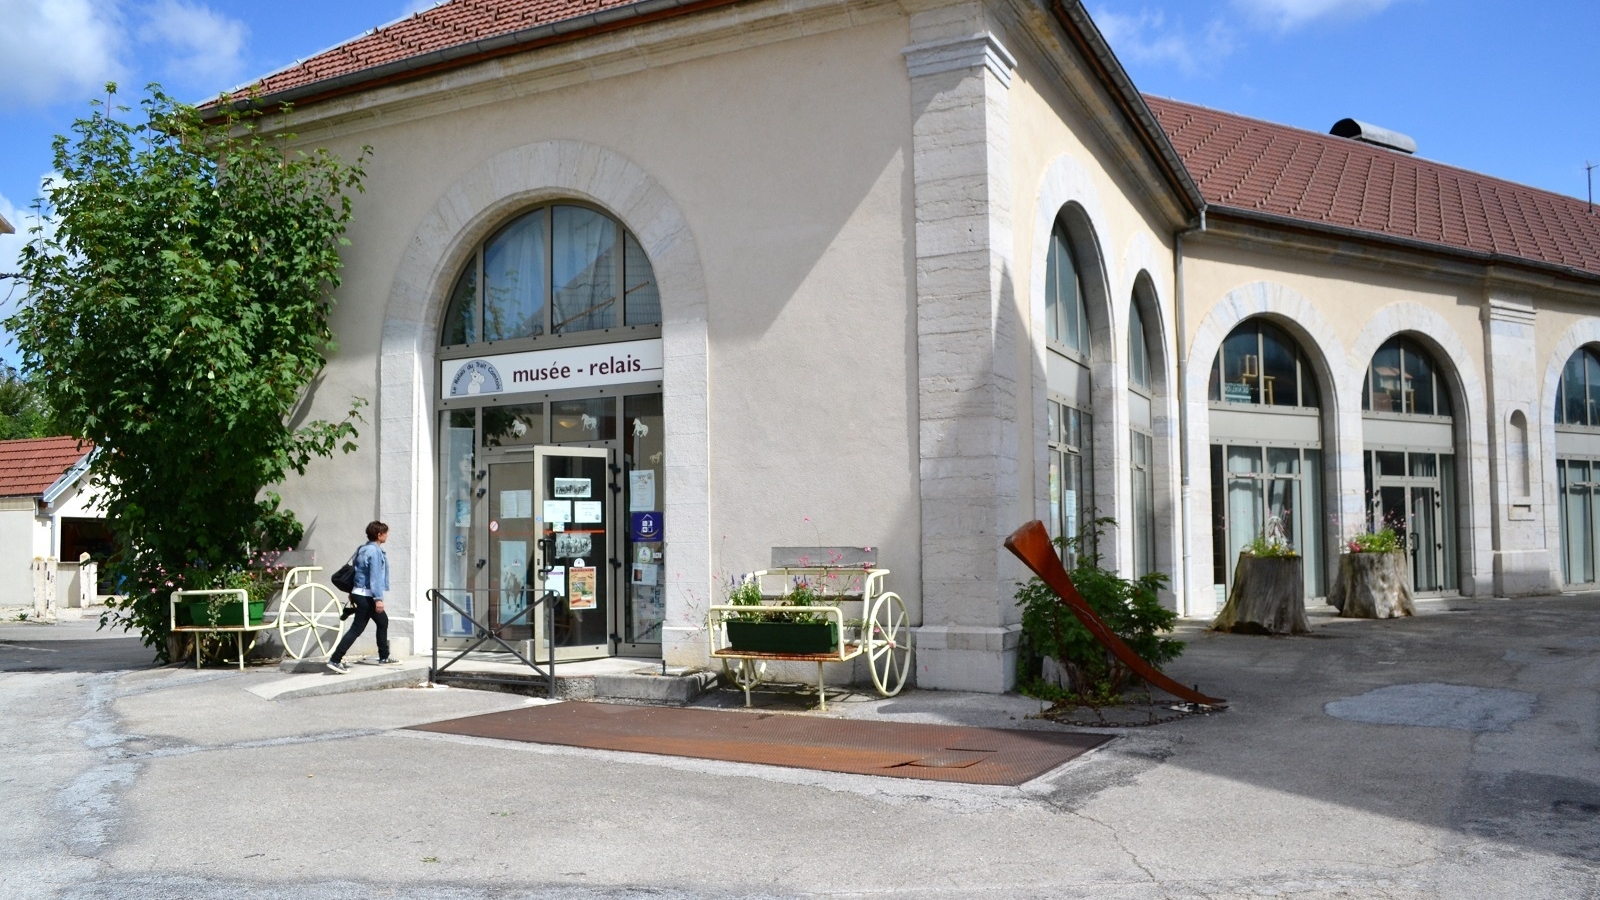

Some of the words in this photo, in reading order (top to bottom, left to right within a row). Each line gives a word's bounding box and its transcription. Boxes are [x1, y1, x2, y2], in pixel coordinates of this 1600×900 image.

[451, 386, 457, 394] Le
[454, 369, 466, 385] Relais
[475, 361, 487, 370] Trait
[512, 361, 571, 383] musée
[589, 354, 641, 376] relais
